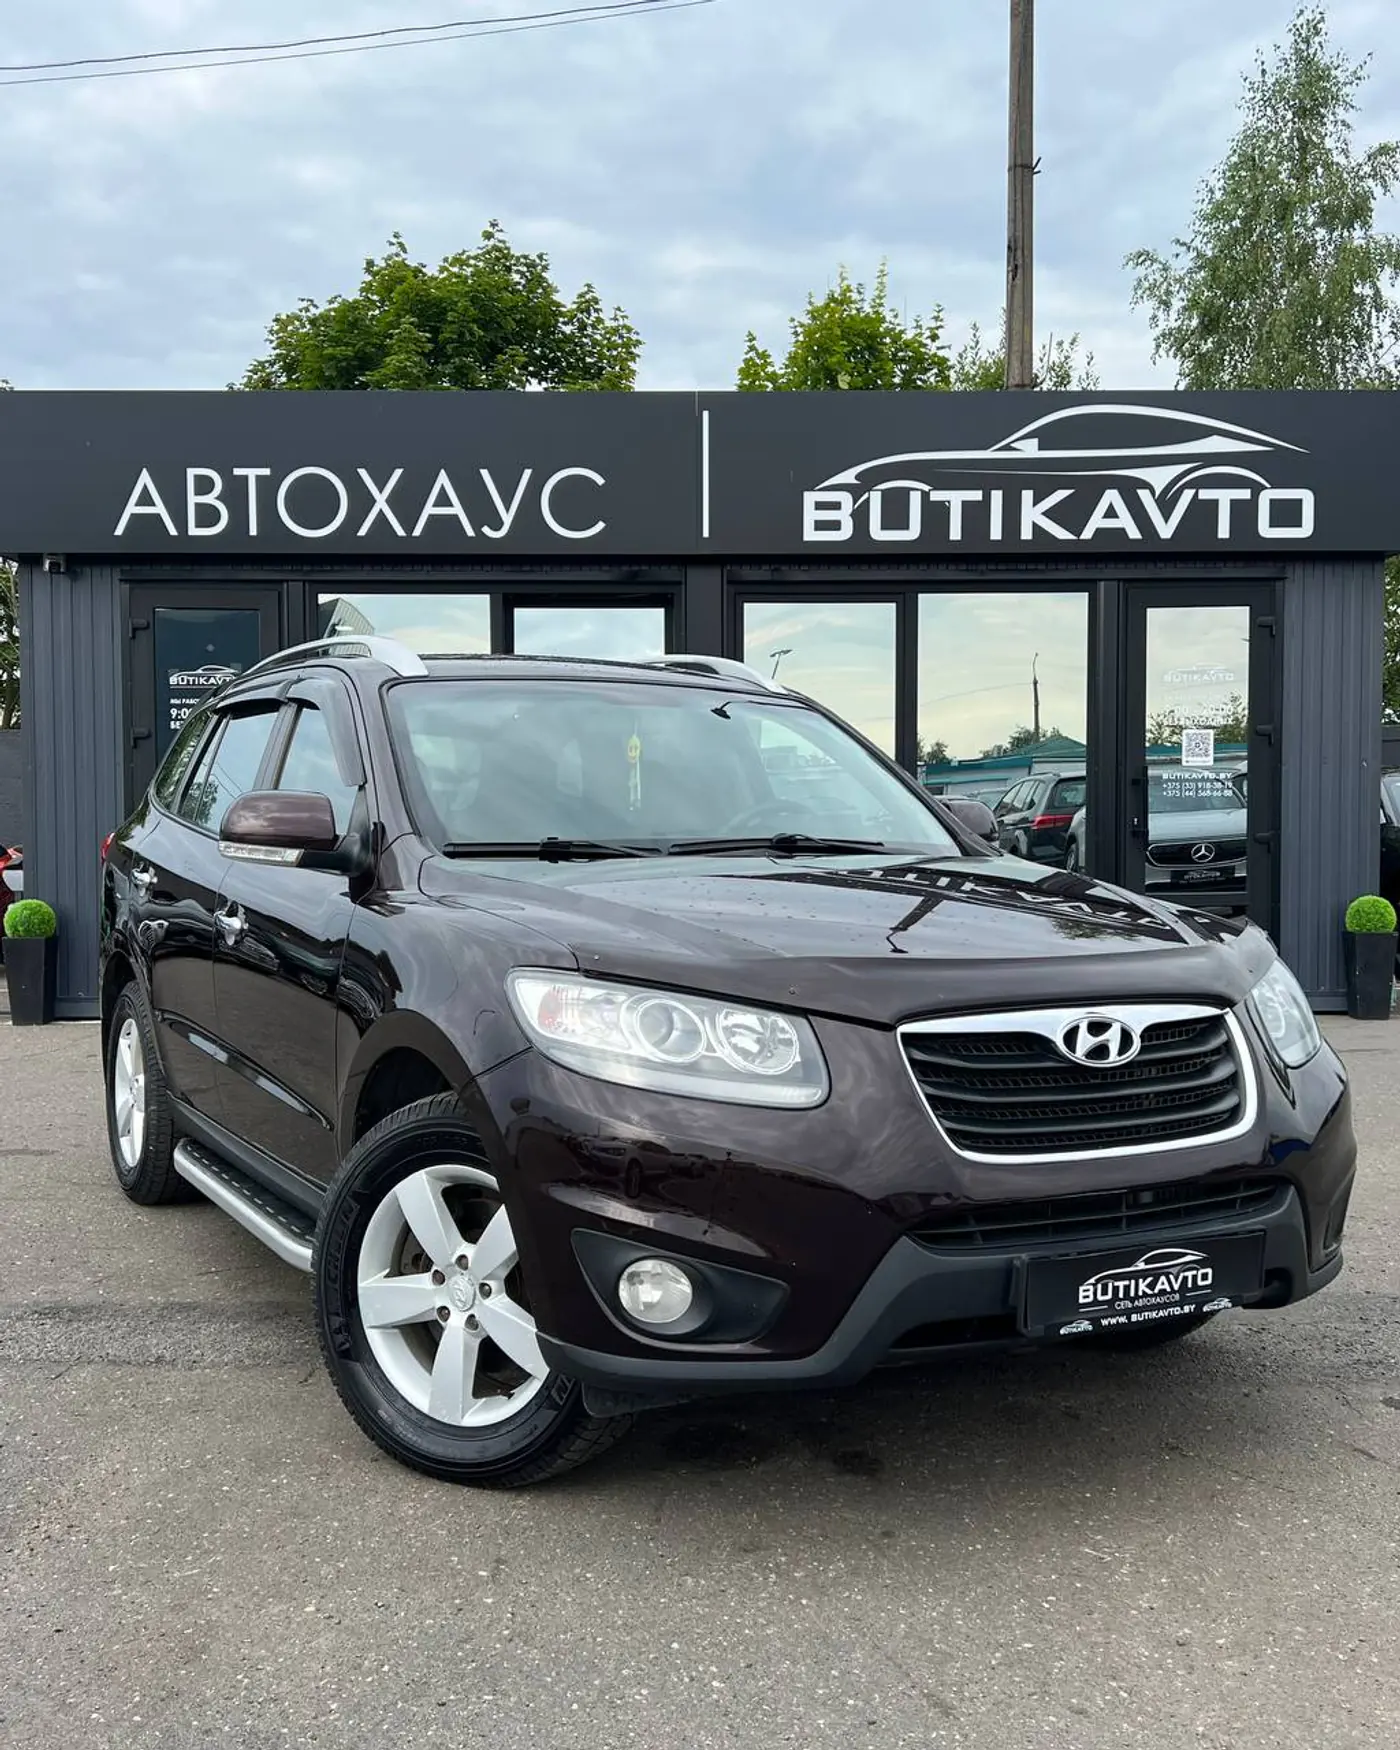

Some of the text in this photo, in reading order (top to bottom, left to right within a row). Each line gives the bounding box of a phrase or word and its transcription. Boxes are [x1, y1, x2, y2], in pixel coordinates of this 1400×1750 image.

[113, 466, 606, 539] АВТОХАУС
[802, 487, 1316, 542] BUTIKAVTO
[169, 676, 232, 685] BUTIKAVT
[170, 708, 192, 719] 9:0
[1078, 1268, 1213, 1304] BUTIKAVTO
[1131, 1304, 1196, 1322] BUTIKAVTO.BY
